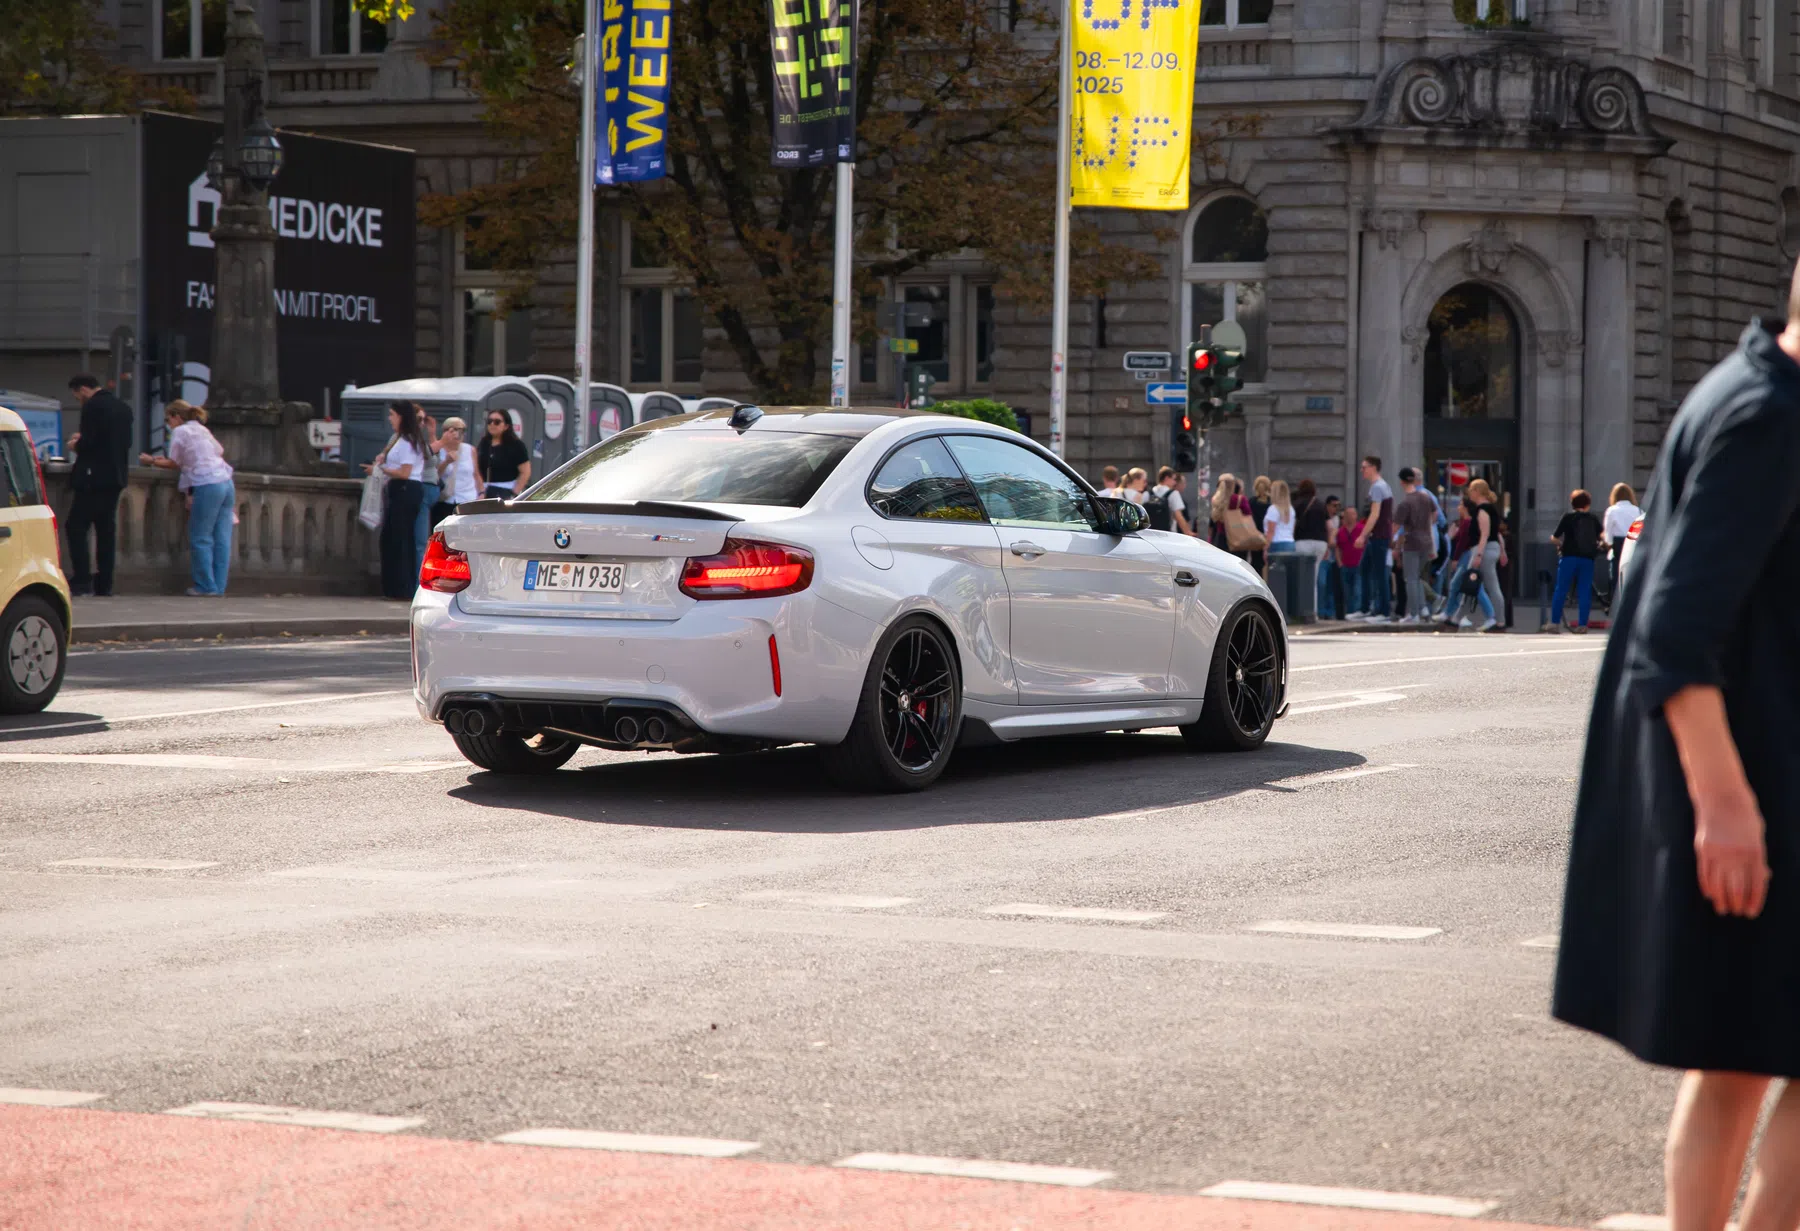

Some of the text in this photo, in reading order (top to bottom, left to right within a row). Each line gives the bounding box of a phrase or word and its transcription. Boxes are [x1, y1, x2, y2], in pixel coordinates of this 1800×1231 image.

[289, 290, 320, 319] MIT
[322, 293, 382, 324] PROFIL
[536, 564, 621, 588] ME M 938
